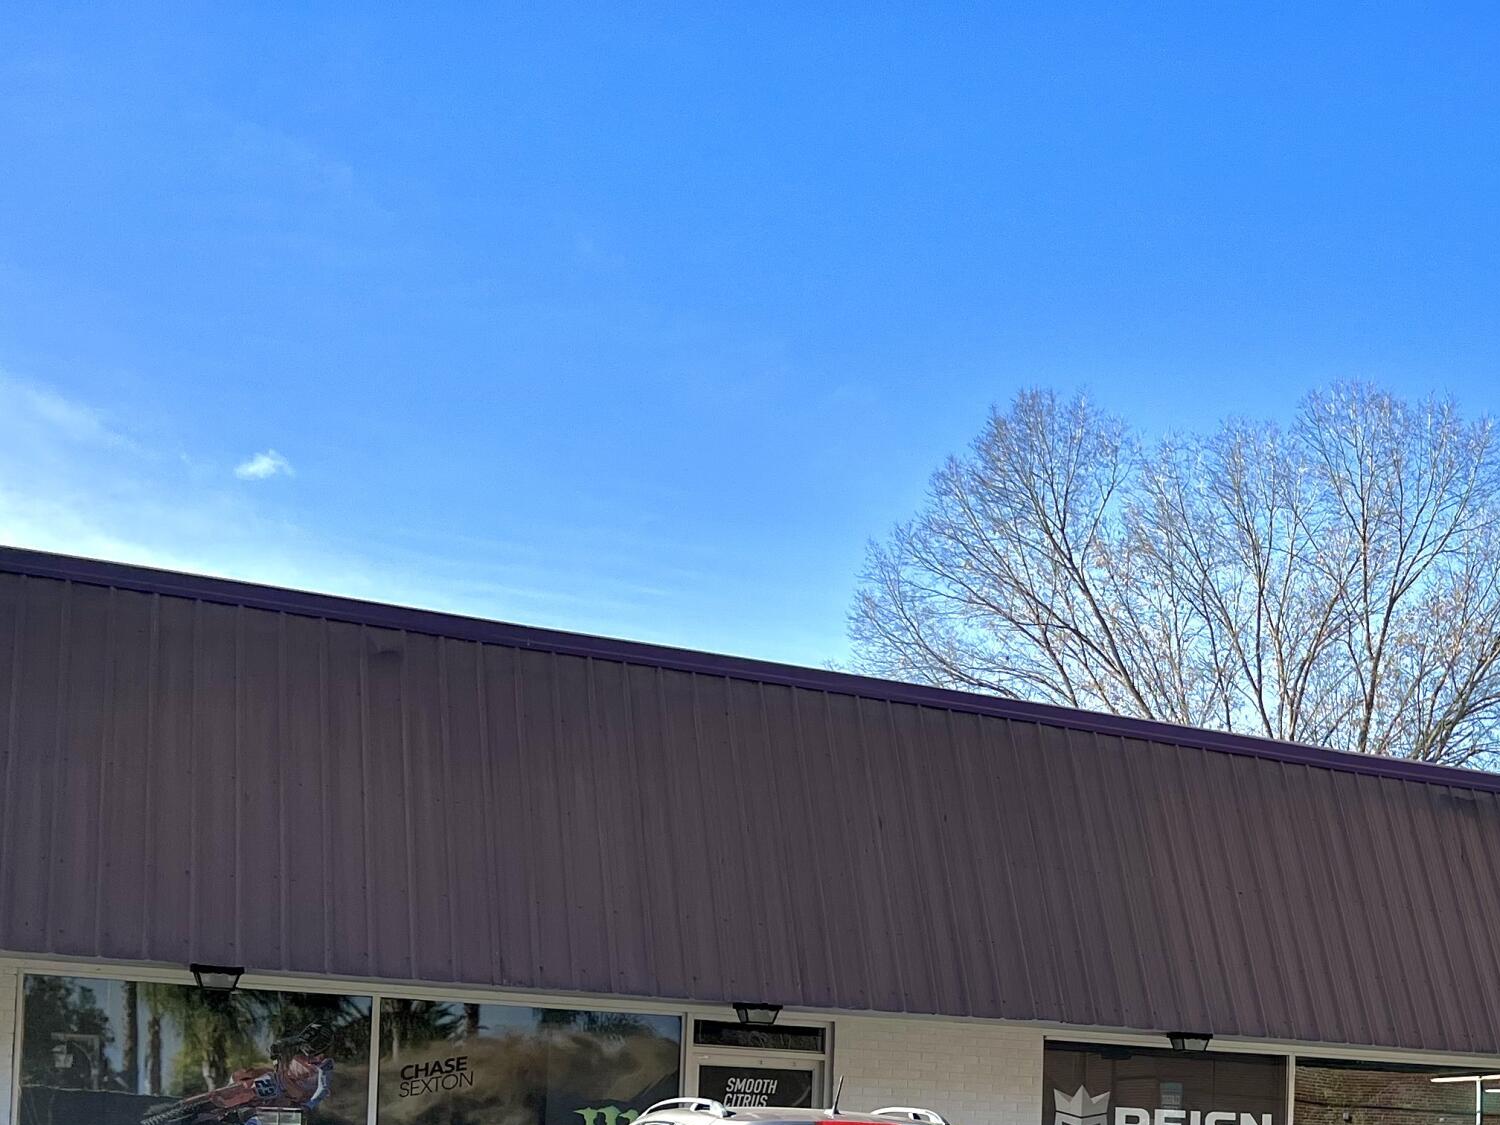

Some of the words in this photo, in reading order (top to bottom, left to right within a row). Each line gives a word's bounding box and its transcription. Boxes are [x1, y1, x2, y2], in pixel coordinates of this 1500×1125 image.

[401, 1056, 468, 1080] CHASE
[399, 1071, 474, 1097] SEXTON
[726, 1077, 778, 1094] SMOOTH
[724, 1093, 768, 1107] CITRUS
